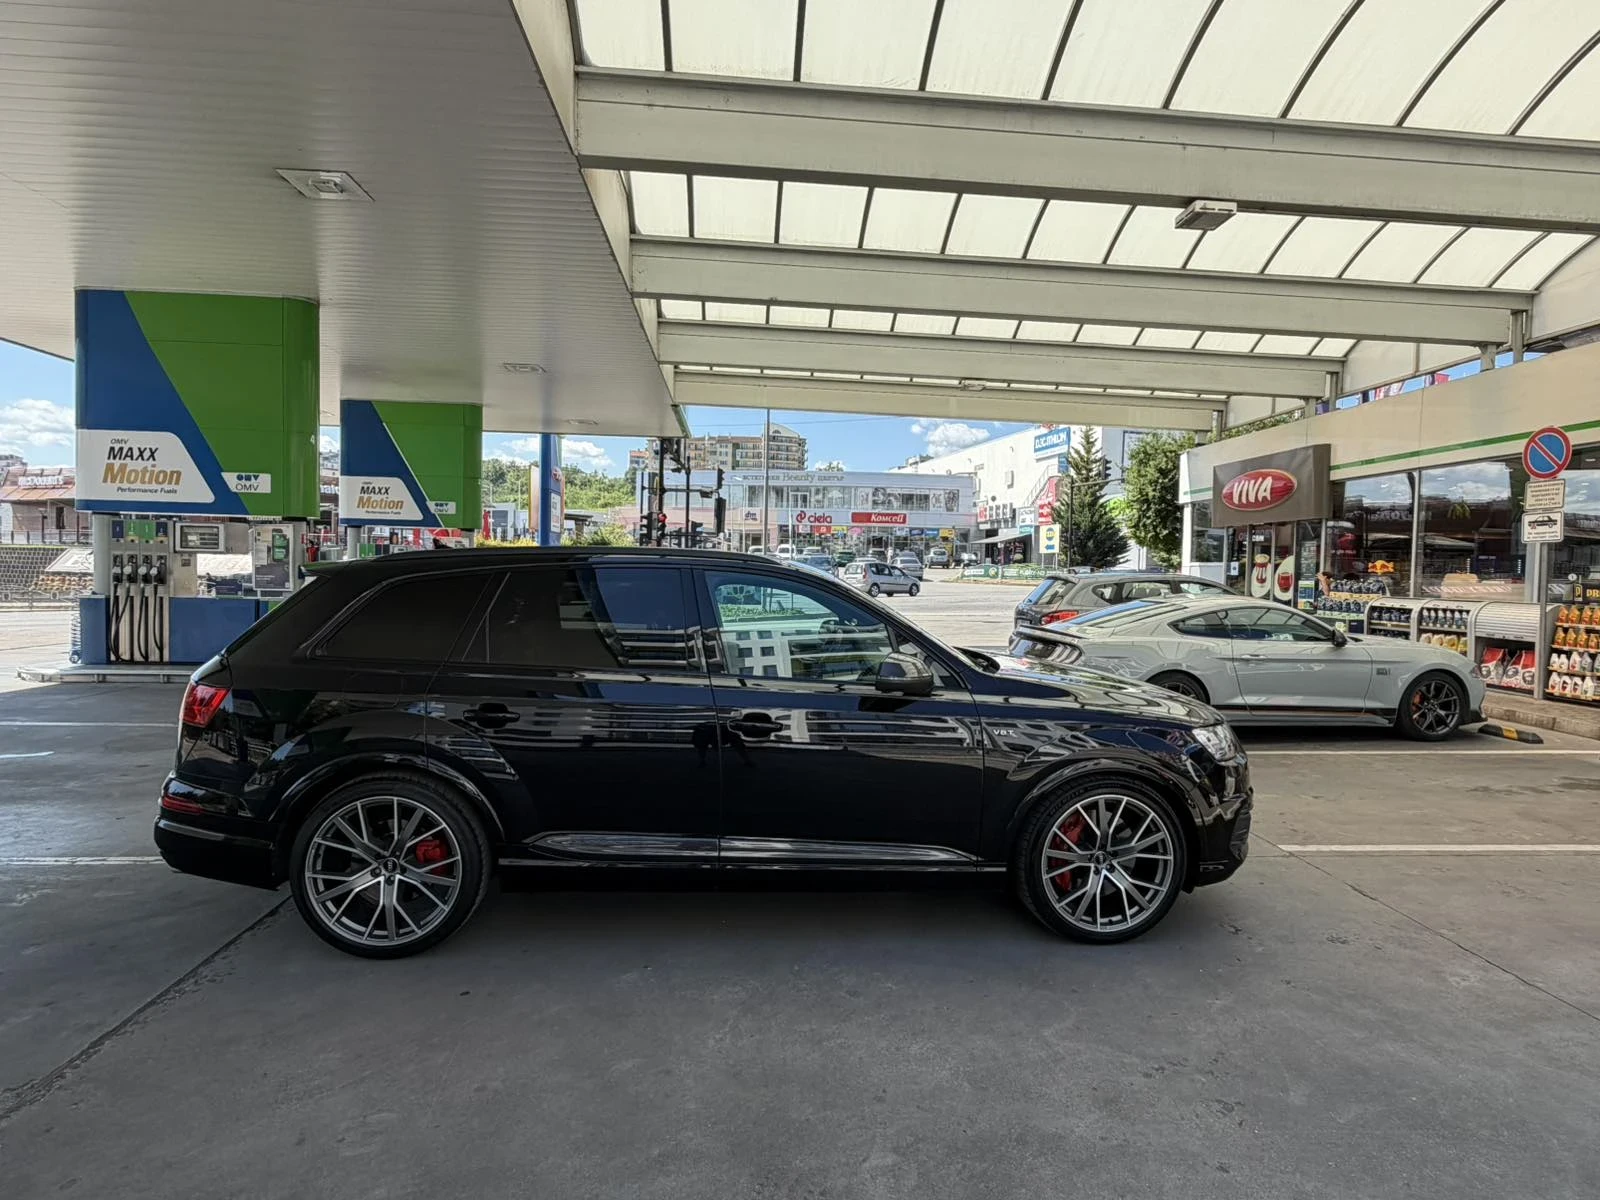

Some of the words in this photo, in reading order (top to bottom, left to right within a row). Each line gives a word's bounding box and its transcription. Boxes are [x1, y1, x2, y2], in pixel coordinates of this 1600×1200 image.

[107, 446, 159, 461] MAXX
[102, 463, 182, 486] Motion
[117, 486, 158, 494] Performance
[235, 483, 260, 491] OMV
[360, 486, 391, 495] MAXX
[1232, 476, 1273, 504] VIVA
[356, 496, 404, 510] Motion
